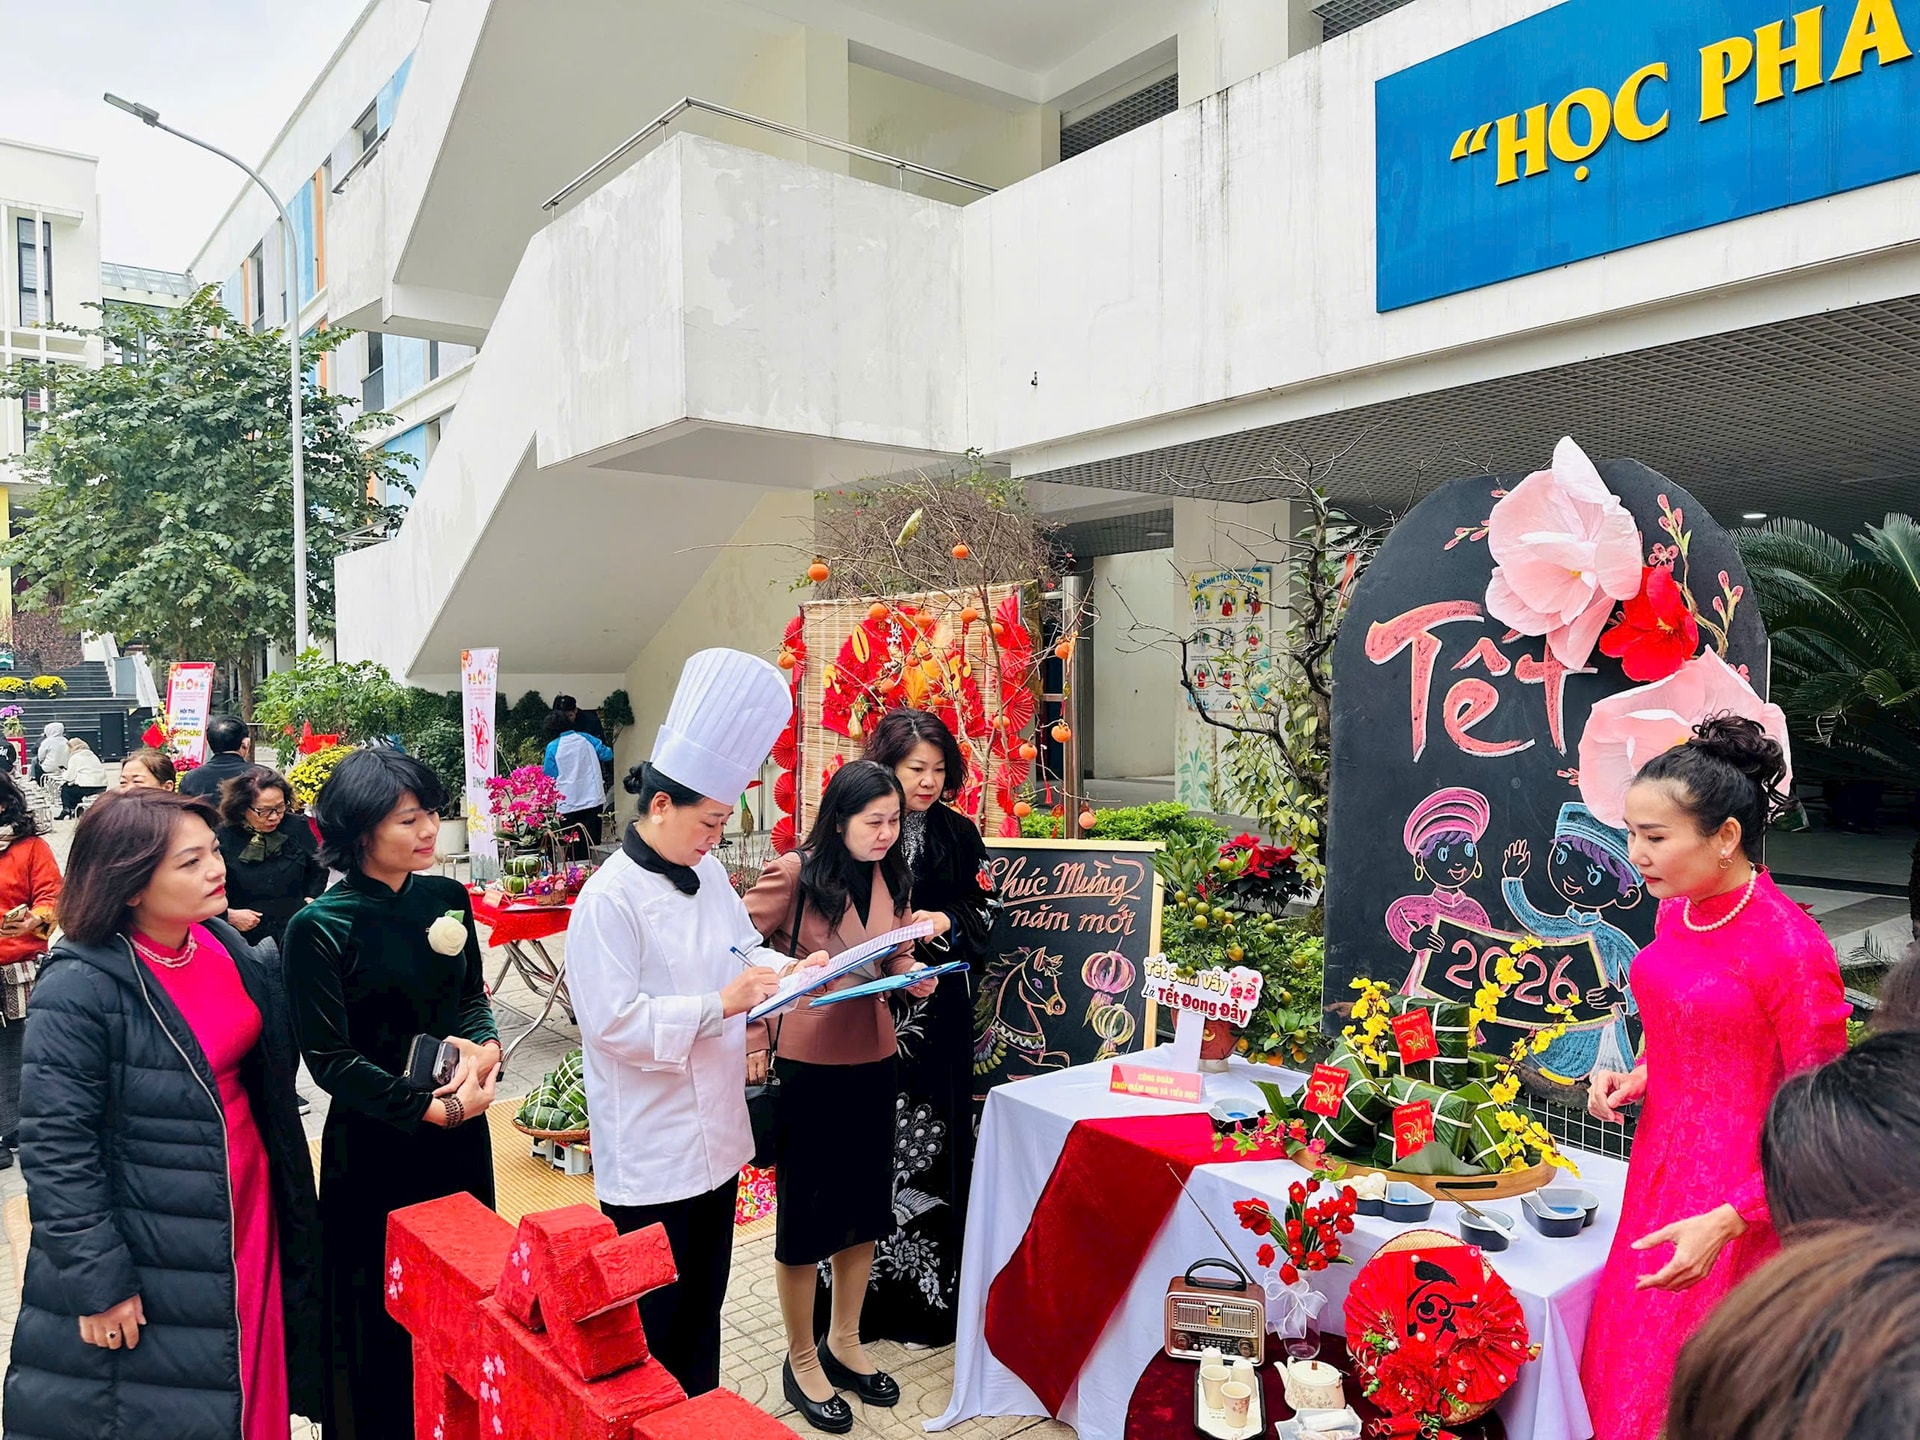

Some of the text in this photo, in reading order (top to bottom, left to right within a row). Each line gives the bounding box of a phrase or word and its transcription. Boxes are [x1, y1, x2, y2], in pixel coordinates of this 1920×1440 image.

[1010, 903, 1136, 936] năm mới
[1145, 957, 1168, 978] Tết
[1445, 939, 1580, 1008] 2026
[1143, 983, 1248, 1024] Là Tết Đong Đầy
